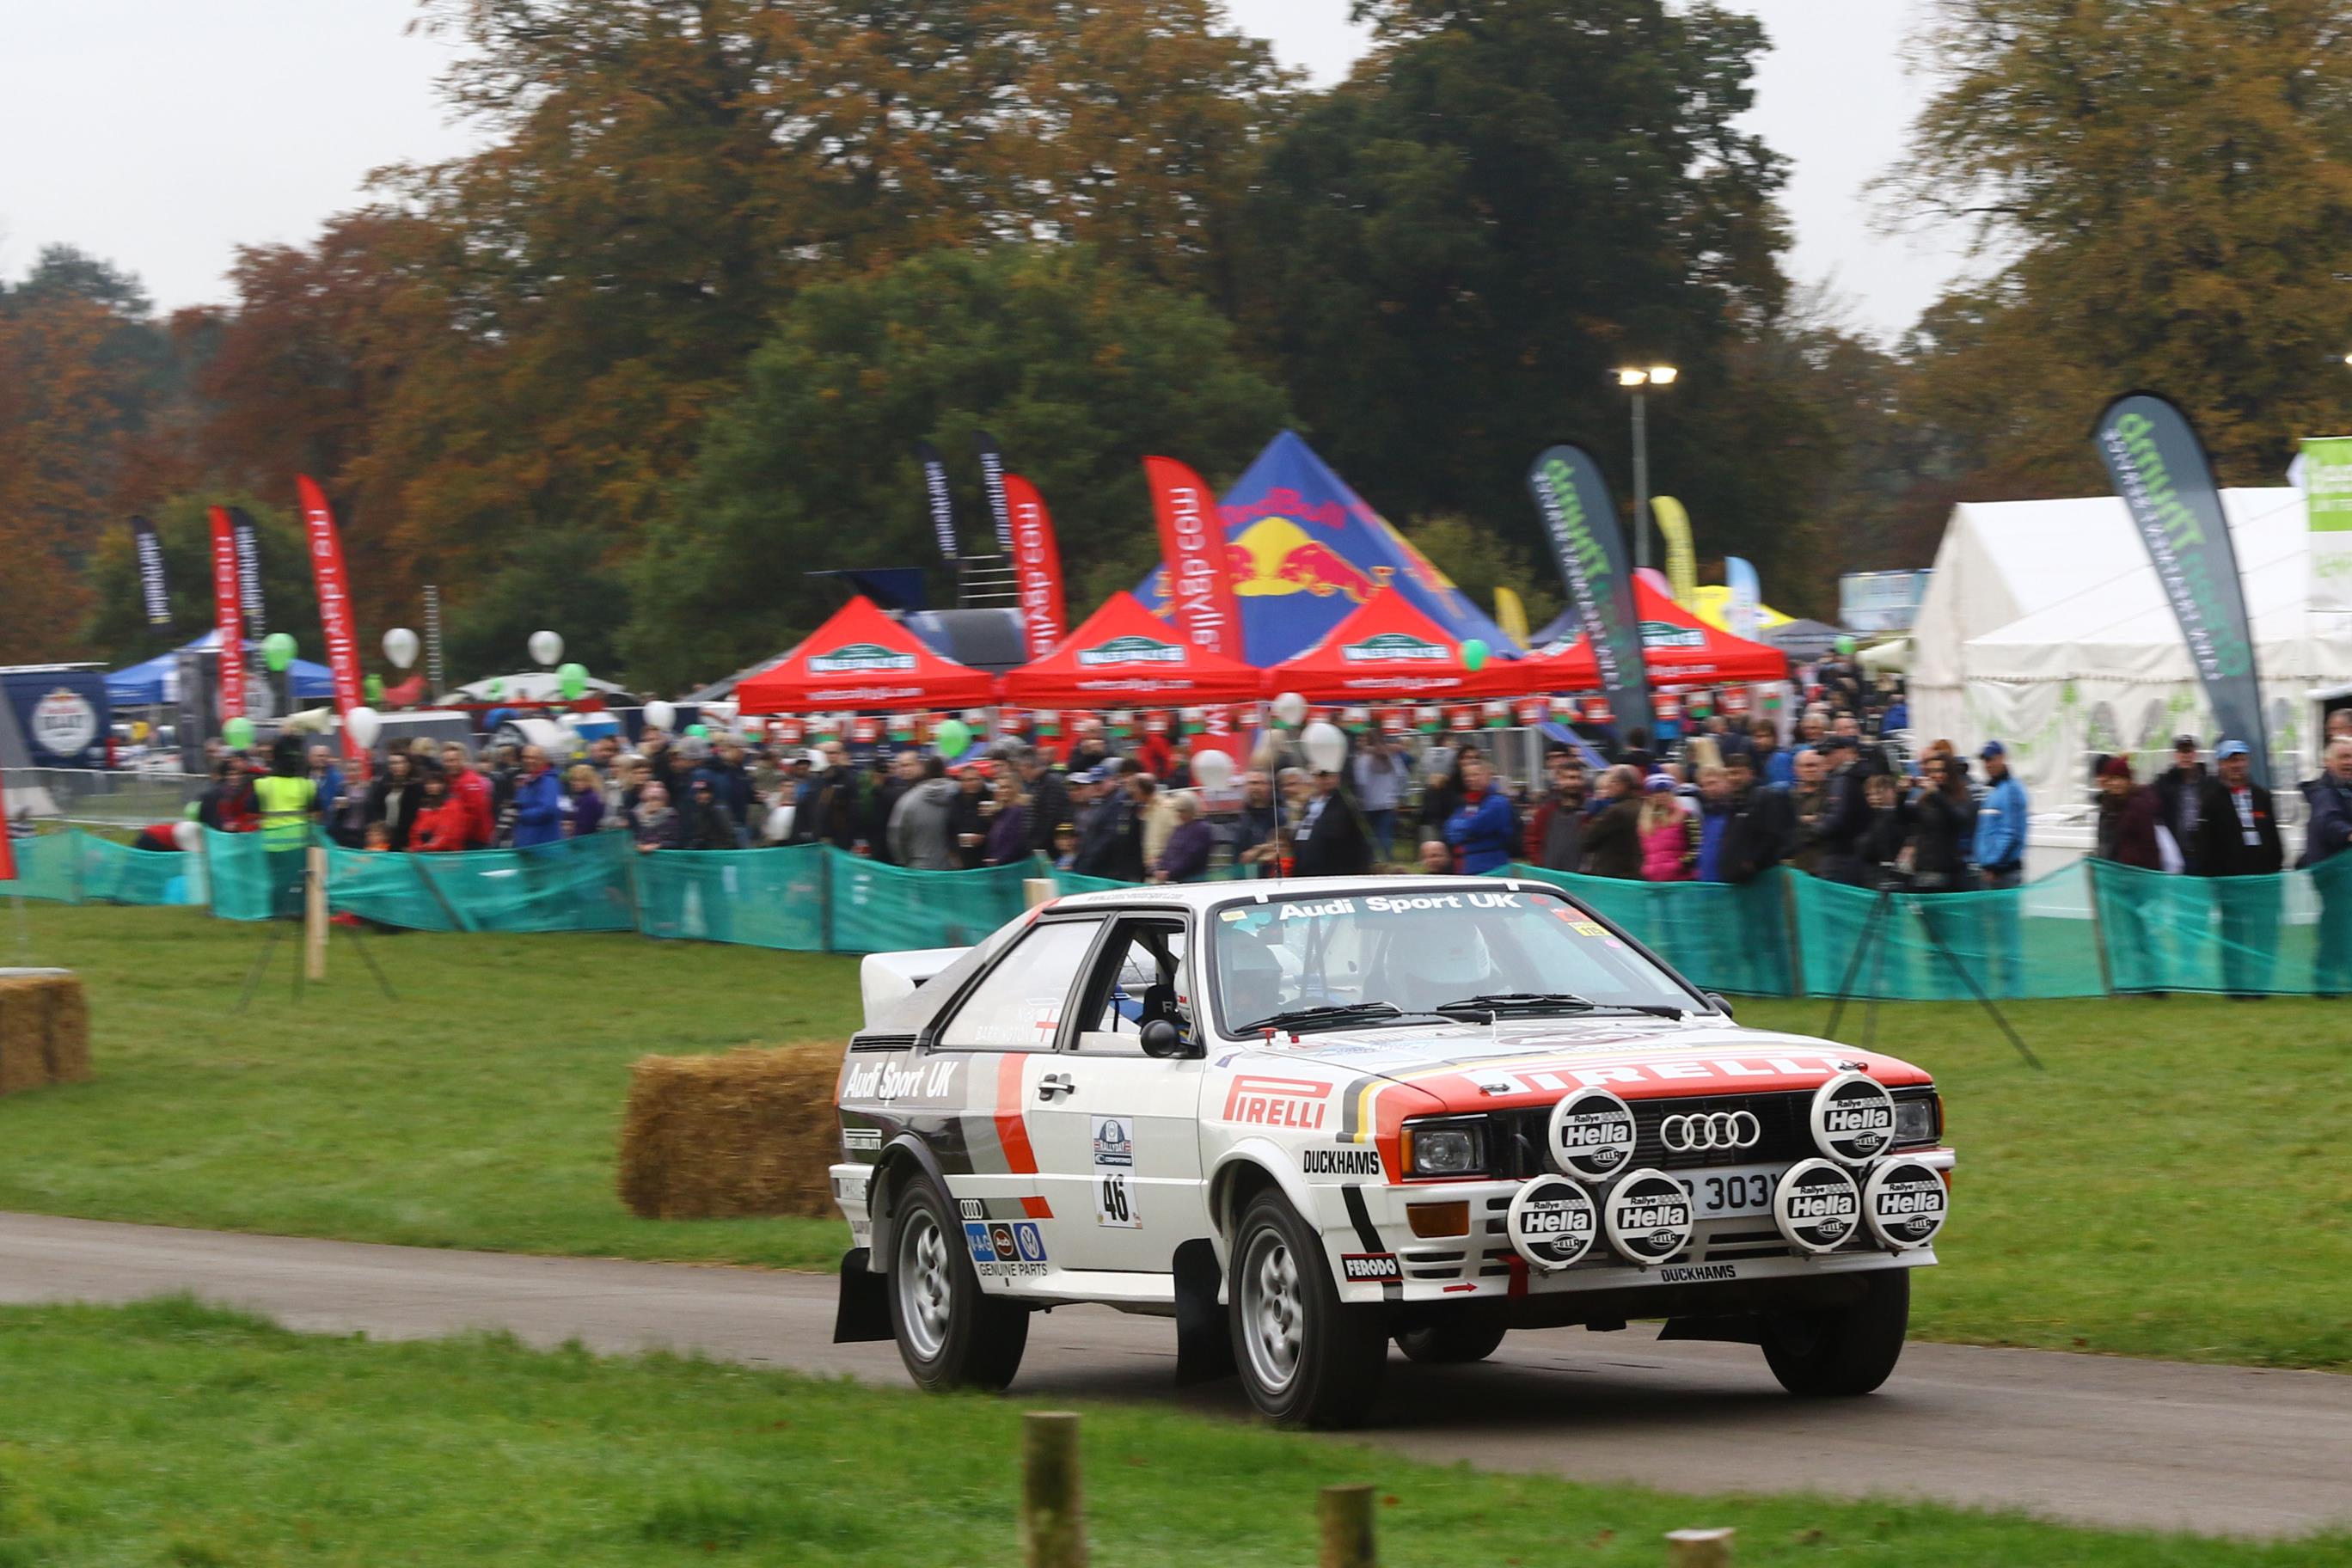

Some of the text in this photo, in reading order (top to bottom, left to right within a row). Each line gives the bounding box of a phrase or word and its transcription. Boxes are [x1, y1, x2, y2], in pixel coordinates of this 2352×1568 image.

[1279, 892, 1522, 921] Audi Sport UK
[843, 1061, 959, 1107] Audi Sport UK
[1222, 1074, 1333, 1130] PIRELLI
[1836, 1099, 1861, 1108] Rallye
[1574, 1114, 1600, 1124] Rallye
[1828, 1109, 1888, 1130] Hella
[1565, 1124, 1627, 1146] Hella
[1303, 1150, 1380, 1175] DUCKHAMS
[1103, 1173, 1129, 1222] 46
[1799, 1185, 1825, 1195] Rallye
[1889, 1183, 1914, 1191] Rallye
[1534, 1201, 1559, 1210] Rallye
[1630, 1196, 1656, 1205] Rallye
[1792, 1196, 1853, 1218] Hella
[1880, 1192, 1940, 1215] Hella
[1525, 1210, 1588, 1232] Hella
[1621, 1206, 1685, 1228] Hella
[978, 1264, 1048, 1277] GENUINE PARTS
[1344, 1259, 1398, 1277] FERODO
[1661, 1265, 1737, 1283] DUCKHAMS
